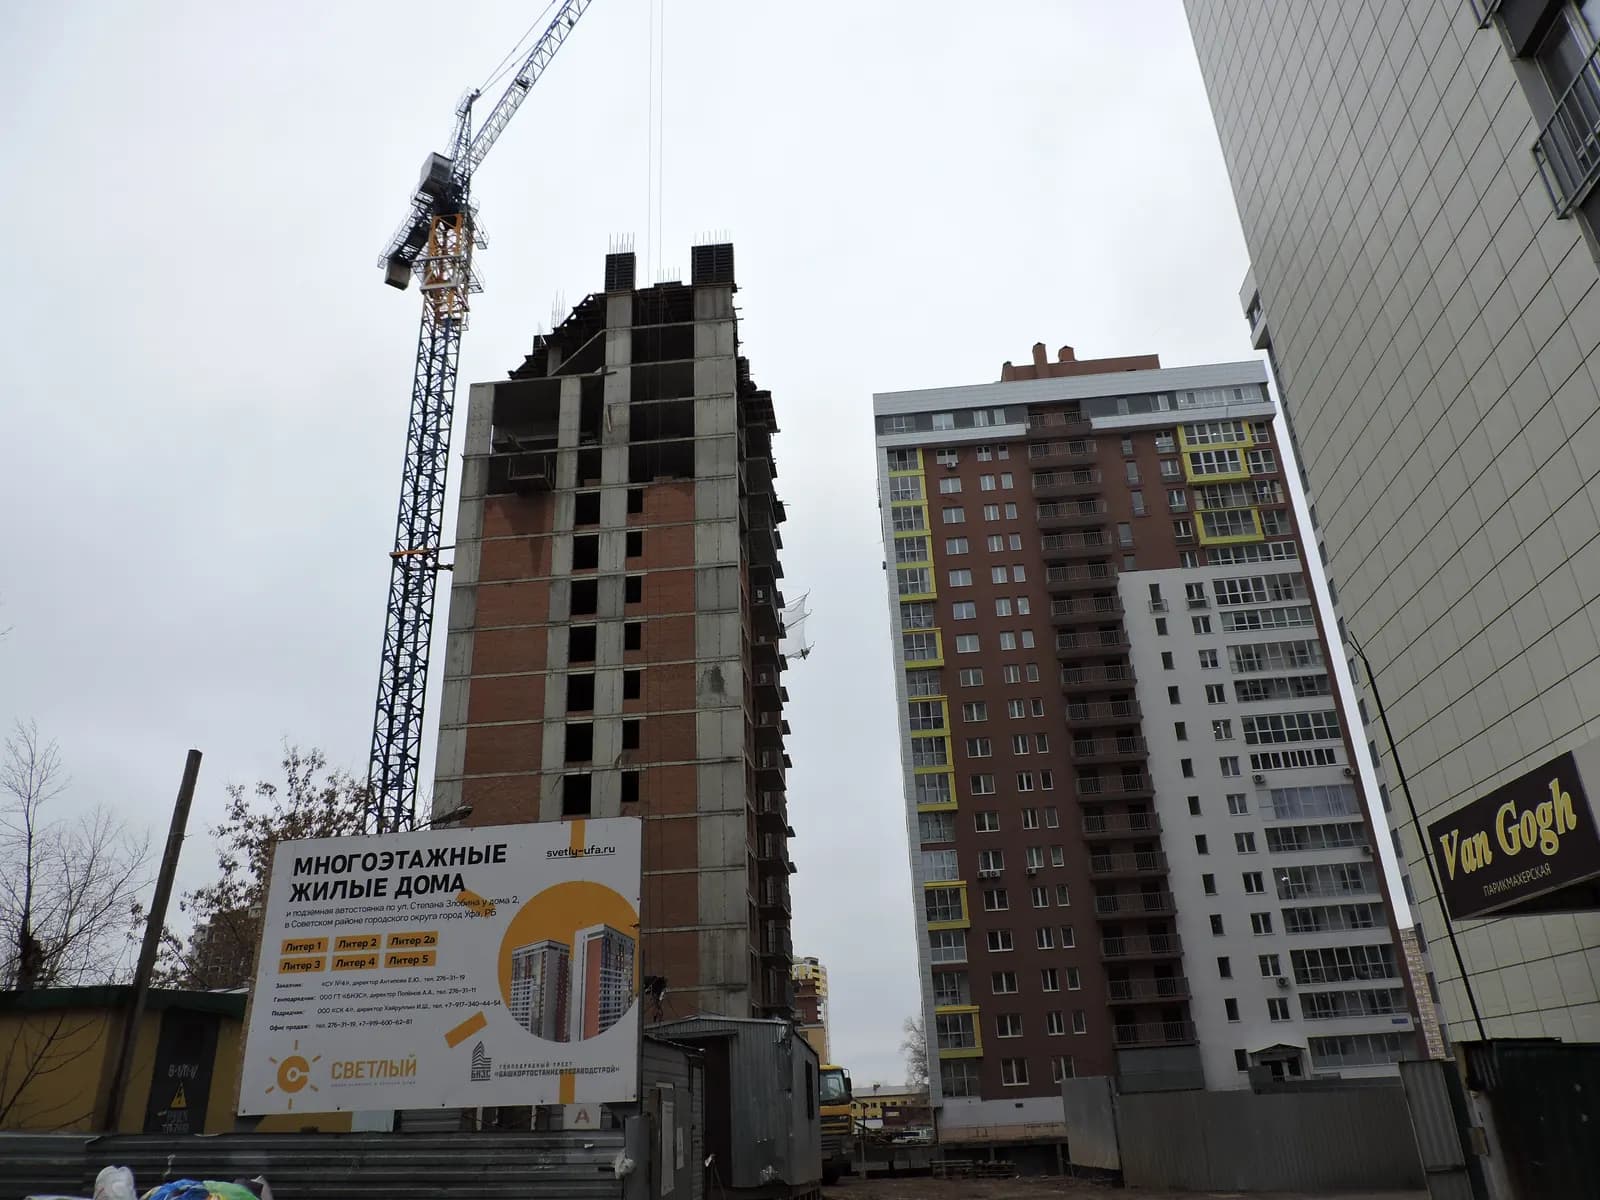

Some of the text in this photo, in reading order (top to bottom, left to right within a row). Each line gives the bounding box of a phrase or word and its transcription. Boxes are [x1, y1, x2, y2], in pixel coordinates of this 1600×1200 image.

[1440, 777, 1577, 881] Van Gogh
[546, 845, 616, 858] svetly-ufa.ru
[293, 844, 507, 876] МНОГОЭТАЖНЫЕ
[1482, 862, 1551, 896] ПАРИКМАХЕРСКАЯ
[289, 873, 466, 903] ЖИЛЫЕ ДОМА
[293, 908, 333, 917] подземная
[335, 904, 384, 914] автостоянка
[397, 903, 408, 912] ул.
[410, 901, 444, 910] Степана
[446, 899, 479, 908] Злобина
[489, 898, 510, 906] дома
[512, 895, 519, 904] 2,
[291, 919, 333, 928] Советском
[334, 917, 363, 927] районе
[365, 914, 408, 925] городского
[410, 913, 438, 923] округа
[439, 911, 462, 921] город
[465, 909, 482, 919] Уфа,
[485, 908, 496, 916] РБ
[285, 942, 322, 953] Литер 1
[339, 938, 377, 949] Литер 2
[391, 937, 421, 947] Литер
[283, 960, 320, 972] Литер 3
[336, 957, 375, 969] Литер 4
[389, 955, 429, 966] Литер 5
[331, 1054, 416, 1080] СВЕТЛЫЙ
